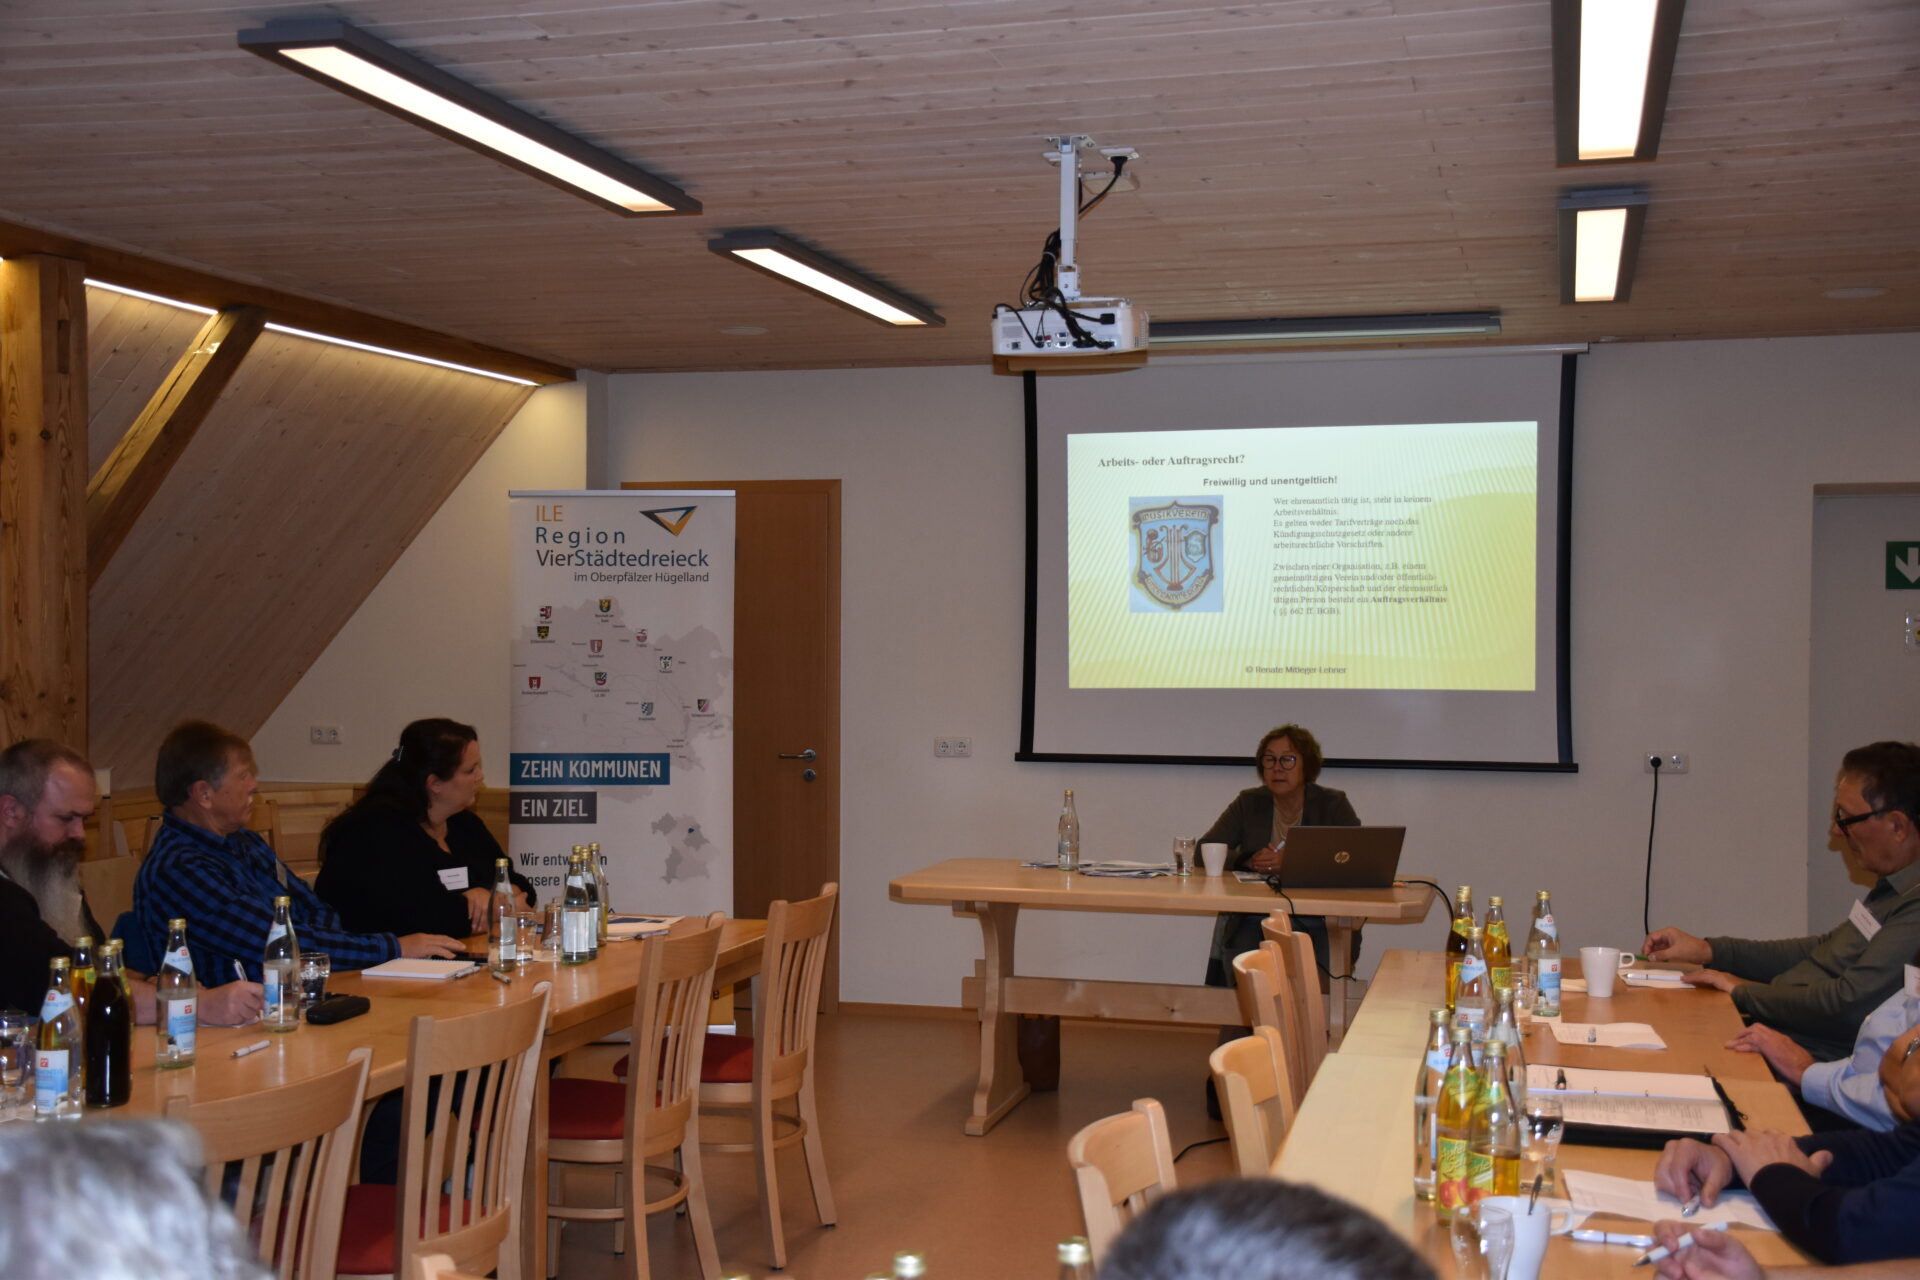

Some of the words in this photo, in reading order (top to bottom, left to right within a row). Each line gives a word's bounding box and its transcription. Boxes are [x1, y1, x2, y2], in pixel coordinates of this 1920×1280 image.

[1097, 457, 1139, 467] Arbeits-
[1142, 456, 1166, 466] oder
[1168, 454, 1245, 467] Auftragsrecht?
[1203, 477, 1246, 487] Freiwillig
[1250, 477, 1268, 486] und
[1271, 476, 1337, 487] unentgeltlich!
[1290, 497, 1339, 505] ehrenamtlich
[1341, 497, 1359, 506] tätig
[1374, 496, 1392, 504] steht
[1394, 496, 1402, 504] in
[1403, 495, 1432, 504] keinem
[536, 504, 564, 522] ILE
[1273, 519, 1283, 527] Es
[1285, 519, 1308, 528] gelten
[1309, 518, 1332, 527] weder
[1335, 518, 1383, 528] Tarifverträge
[1385, 517, 1404, 526] noch
[1406, 517, 1419, 526] das
[535, 527, 625, 548] Region
[1368, 529, 1386, 537] oder
[536, 549, 709, 567] VierStädtedreieck
[1273, 562, 1310, 571] Zwischen
[1311, 563, 1329, 571] einer
[574, 572, 588, 582] im
[590, 571, 652, 584] Oberpfälzer
[655, 571, 709, 585] Hügelland
[1334, 573, 1359, 582] Verein
[1273, 585, 1315, 593] rechtlichen
[1316, 584, 1365, 594] Körperschaft
[1367, 584, 1382, 593] und
[1383, 584, 1396, 592] der
[1300, 596, 1326, 604] Person
[1371, 595, 1447, 605] Auftragsverhältnis
[1255, 666, 1283, 674] Renate
[520, 759, 564, 778] ZEHN
[569, 759, 661, 778] KOMMUNEN
[521, 799, 548, 817] EIN
[552, 799, 589, 817] ZIEL
[520, 852, 539, 866] Wir
[1334, 851, 1350, 864] hp
[526, 875, 560, 887] nsere
